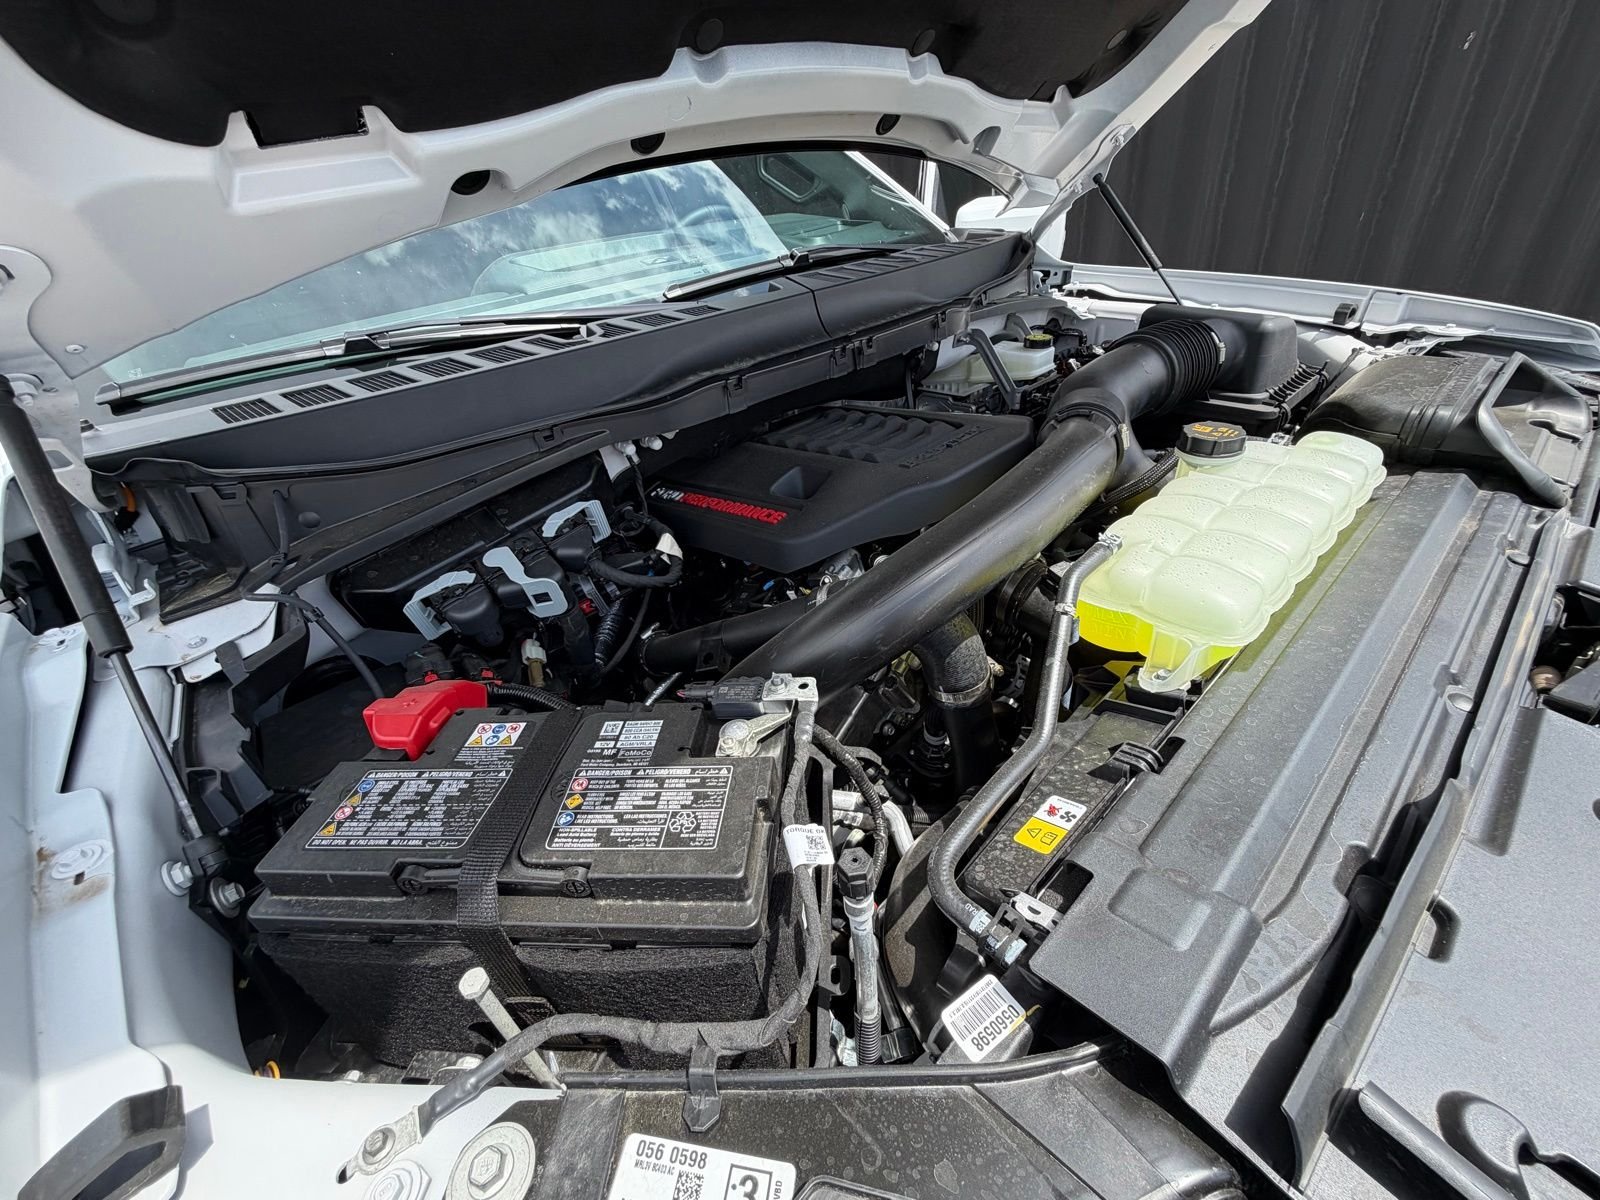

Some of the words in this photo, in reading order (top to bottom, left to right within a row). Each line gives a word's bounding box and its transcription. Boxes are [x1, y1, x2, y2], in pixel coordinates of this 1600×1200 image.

[681, 491, 788, 525] PERFORMANCE
[964, 903, 979, 916] RAD
[971, 1004, 1020, 1051] 0560598
[636, 1139, 666, 1161] 056
[669, 1146, 708, 1170] 0598
[738, 1174, 759, 1200] 3
